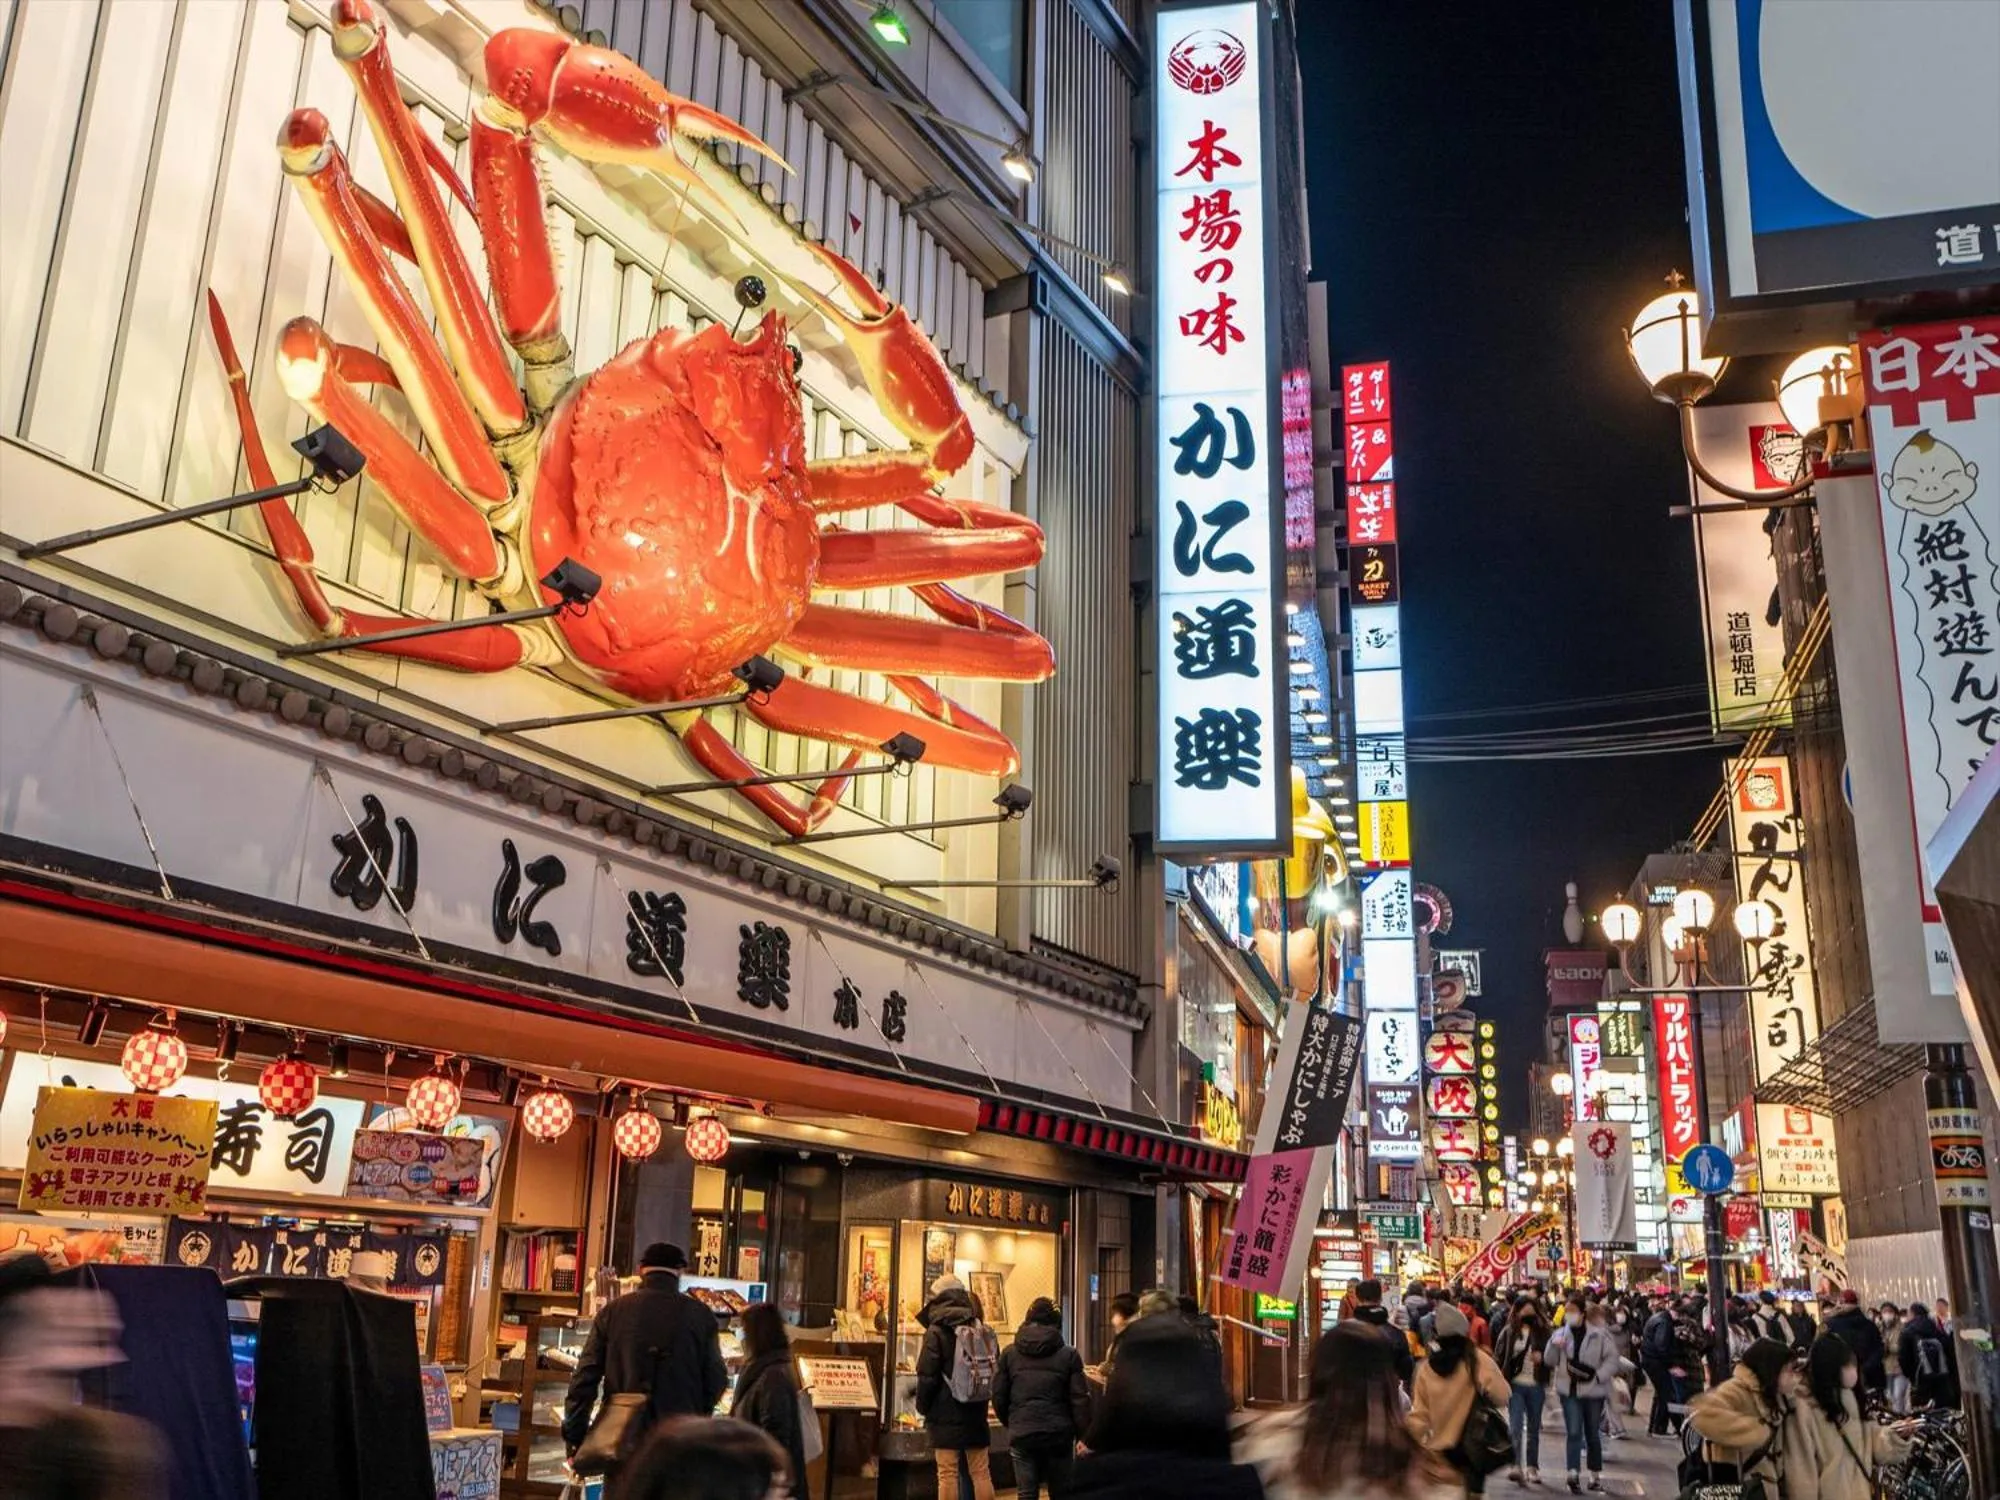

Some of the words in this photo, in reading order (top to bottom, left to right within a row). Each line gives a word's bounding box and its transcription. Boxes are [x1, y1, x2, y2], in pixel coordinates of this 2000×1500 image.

[1174, 120, 1246, 356] 本場の味
[1935, 223, 2000, 267] 道
[1169, 402, 1262, 790] かに道楽
[1726, 611, 1757, 697] 道頓堀店
[1913, 519, 2000, 781] 絶対遊んで
[330, 794, 791, 1011] かに道楽
[1281, 1013, 1330, 1145] 特大かにしゃぶ
[1663, 1002, 1697, 1143] ツルハドラッグ
[111, 1099, 155, 1119] 大阪
[35, 1121, 209, 1159] いらっしゃいキャンペーン
[49, 1145, 196, 1168] ご利用可能なクーポン
[62, 1189, 171, 1209] ご利用できます。
[70, 1167, 173, 1188] 電子アプリと紙
[948, 1183, 1023, 1220] かに道楽
[123, 1225, 158, 1240] 毛かに
